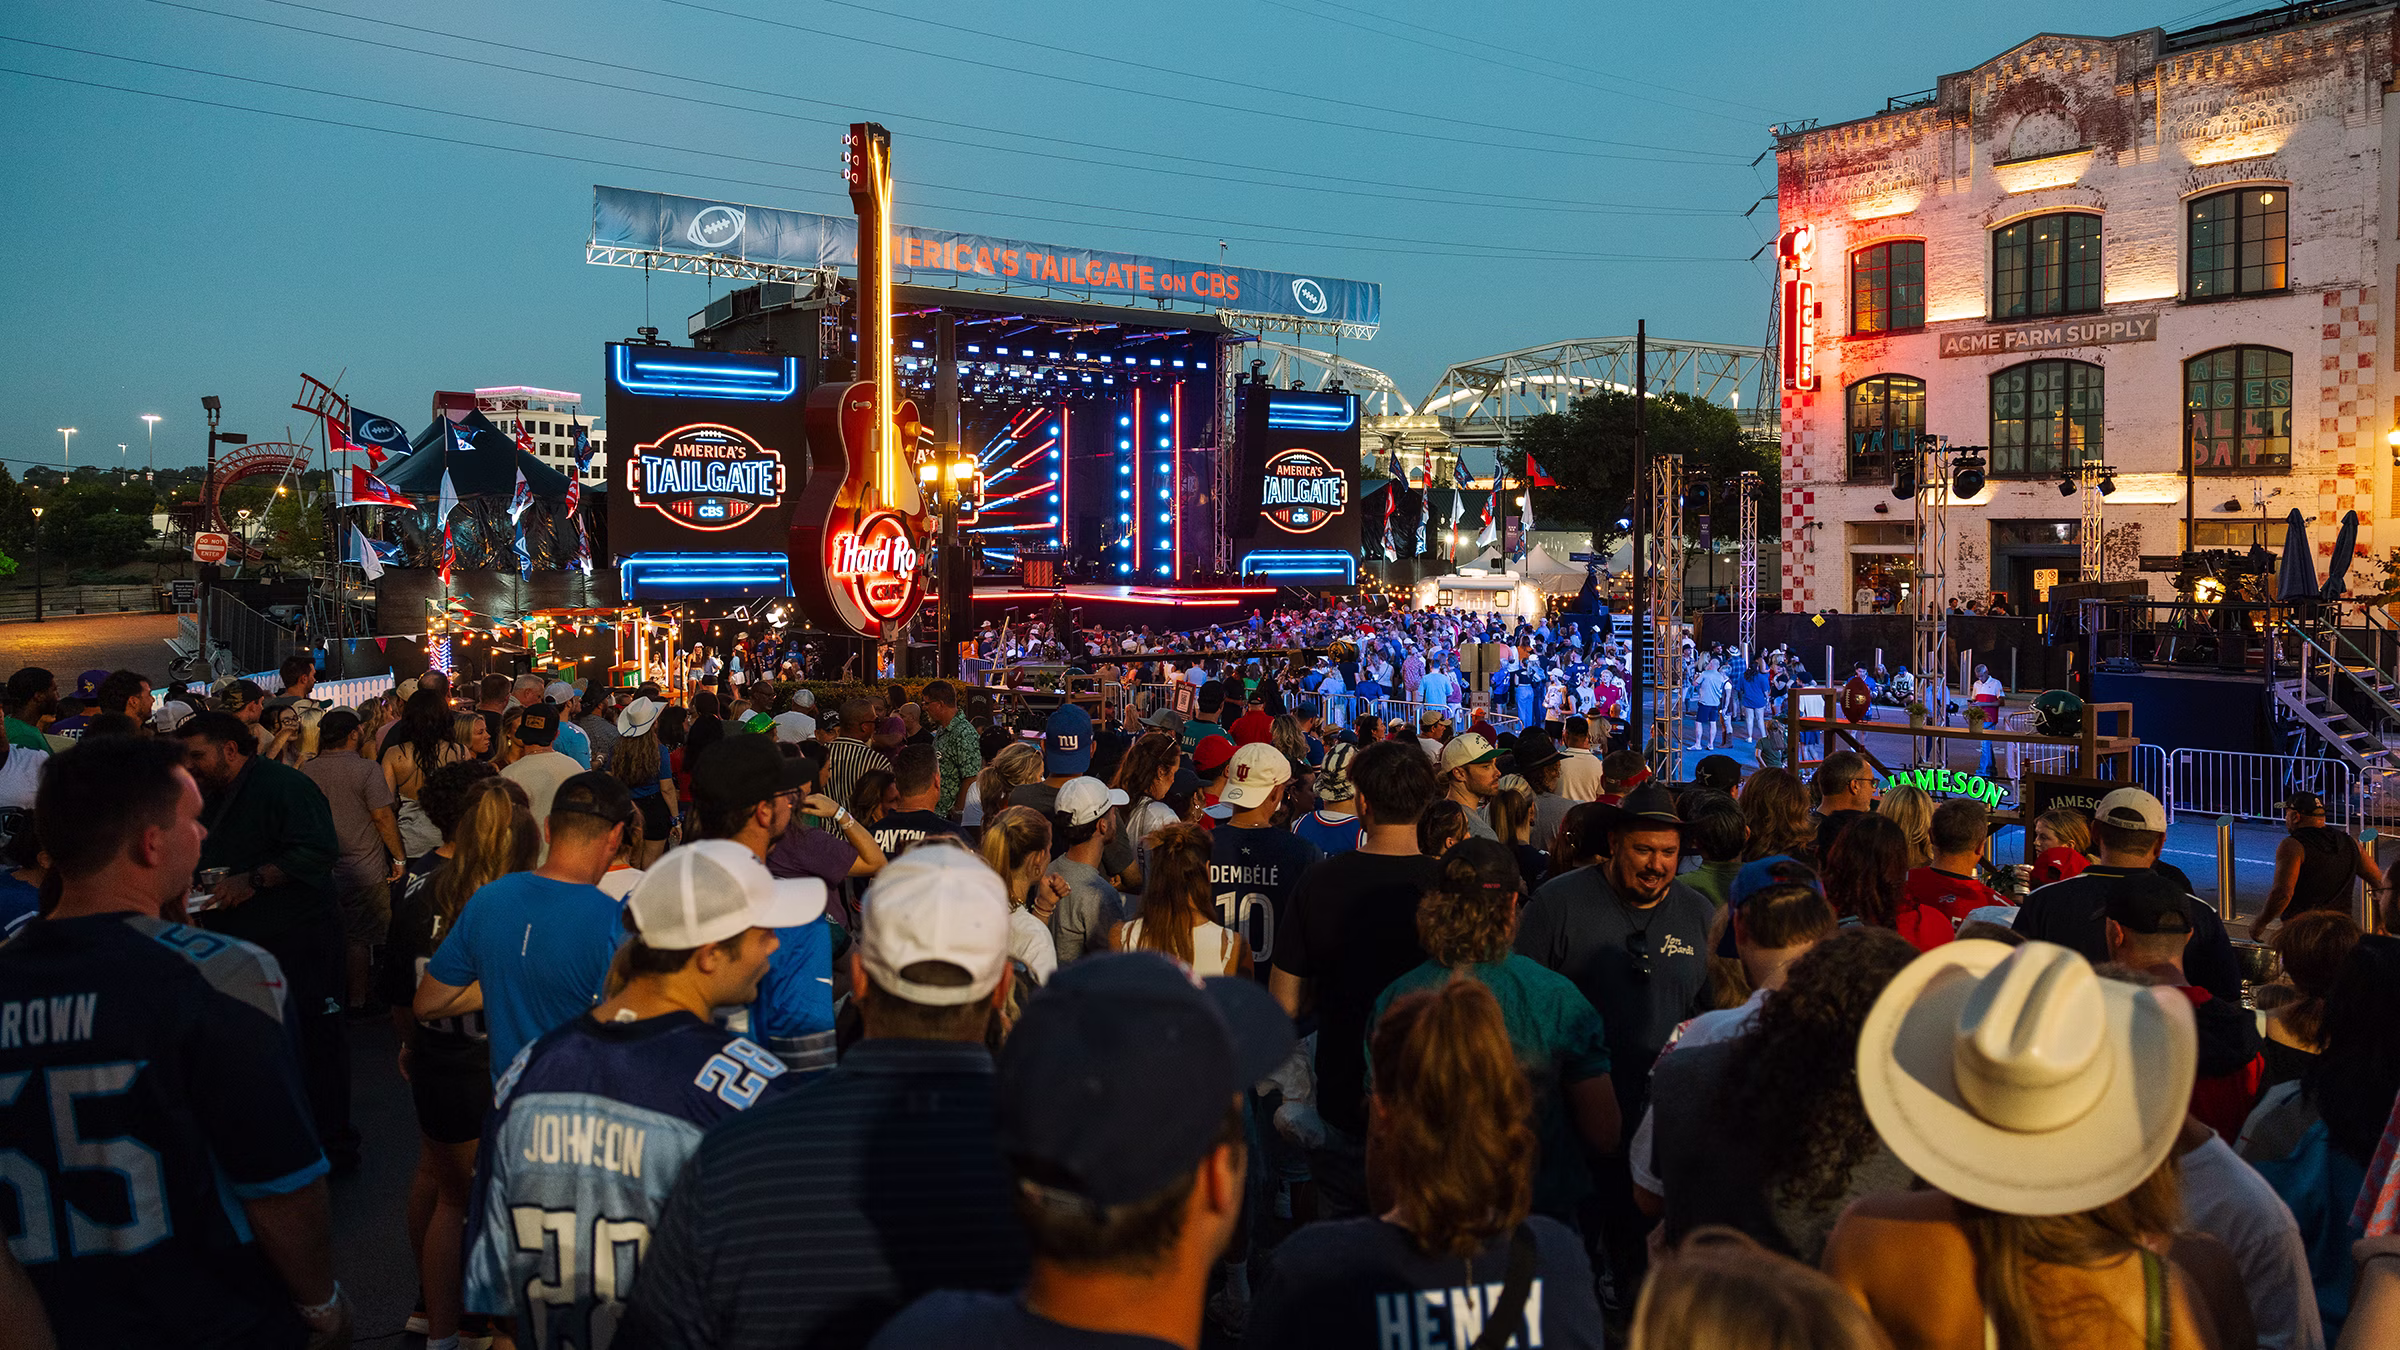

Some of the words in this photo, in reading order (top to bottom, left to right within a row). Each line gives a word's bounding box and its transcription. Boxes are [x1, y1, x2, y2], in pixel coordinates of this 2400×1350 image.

[851, 236, 1018, 277] MERICA'S
[1026, 253, 1155, 291] TAILGATE
[1160, 273, 1187, 292] ON
[1191, 271, 1240, 300] CBS
[1945, 333, 2000, 353] ACME
[2004, 327, 2061, 348] FARM
[2066, 318, 2150, 342] SUPPLY
[2193, 356, 2262, 379] ALL
[2033, 369, 2101, 414] BEER
[2193, 378, 2289, 408] AGES
[2192, 409, 2263, 438] ALL
[672, 443, 747, 459] AMERICA'S
[2193, 439, 2261, 465] DAY
[641, 455, 774, 496] TAILGATE
[1276, 464, 1323, 476] AMERICA'S
[699, 505, 724, 517] CBS
[1292, 513, 1309, 522] CBS
[841, 535, 892, 573] Hard
[2051, 700, 2065, 715] J
[1058, 735, 1079, 751] ny
[1888, 769, 2004, 808] JAMESON
[1210, 864, 1279, 886] DEMBÉLÉ
[1216, 891, 1275, 962] 10
[0, 992, 98, 1050] ROWN
[694, 1037, 788, 1111] 28
[524, 1114, 646, 1178] JOHNSON
[1376, 1278, 1544, 1350] HENY
